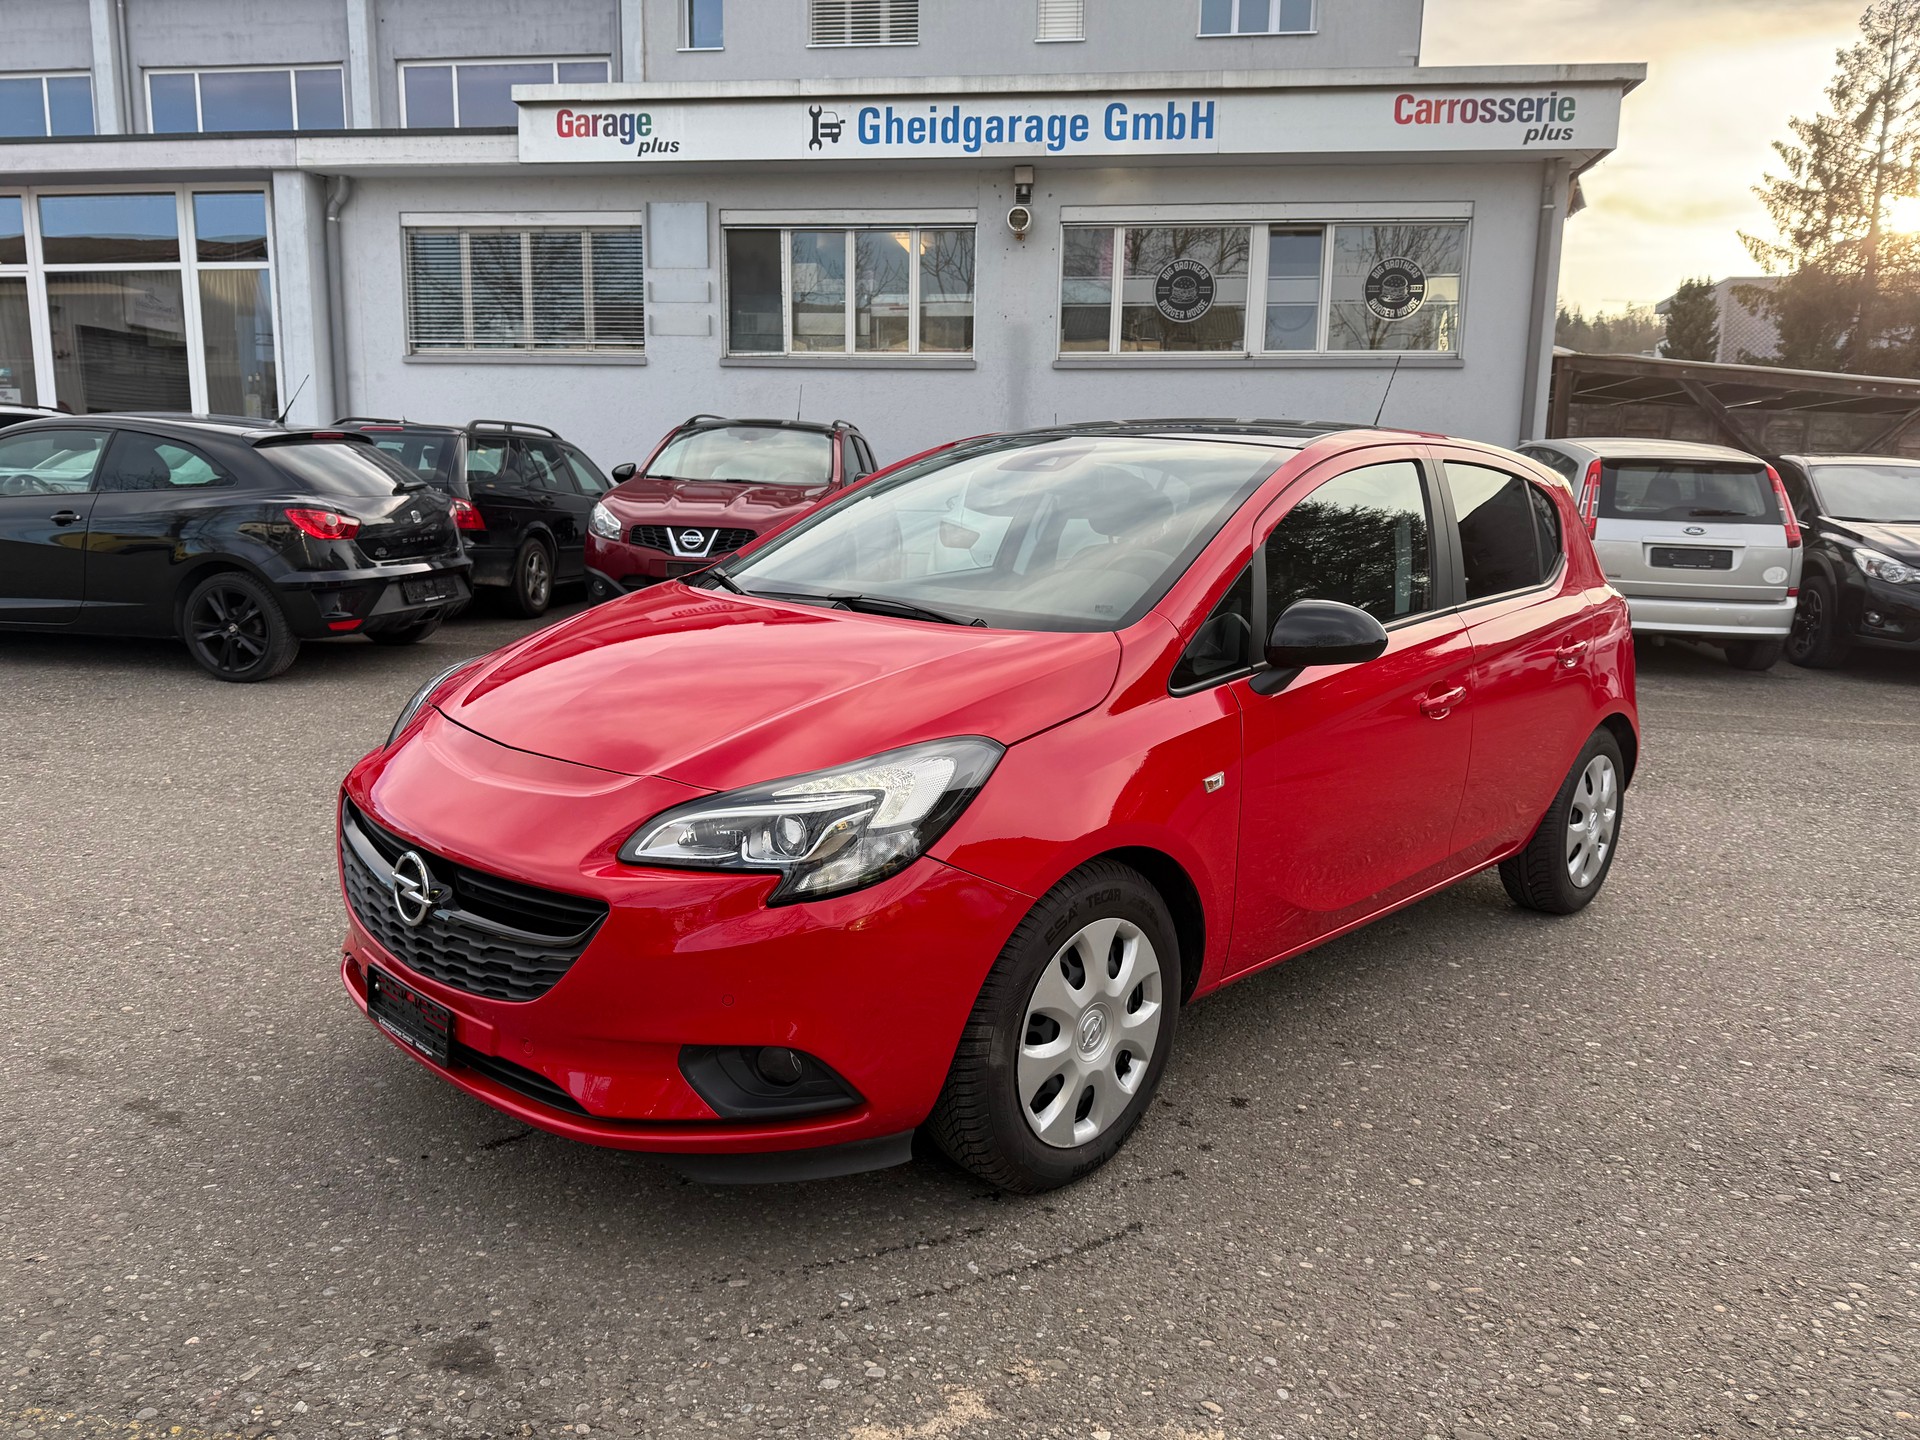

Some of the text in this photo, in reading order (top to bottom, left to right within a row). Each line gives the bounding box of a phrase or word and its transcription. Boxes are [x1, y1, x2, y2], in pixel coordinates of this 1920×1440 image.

[1394, 91, 1576, 125] Carrosserie
[556, 108, 652, 145] Garage
[857, 101, 1215, 153] Gheidgarage GmbH
[1522, 123, 1574, 145] plus
[637, 137, 680, 157] plus
[1161, 261, 1209, 280] BIG BROTHERS
[1371, 260, 1421, 279] BIG BROTHERS
[1159, 299, 1209, 319] BURGER HOUSE
[1368, 297, 1420, 318] BURGER HOUSE
[1086, 888, 1121, 909] TECAR
